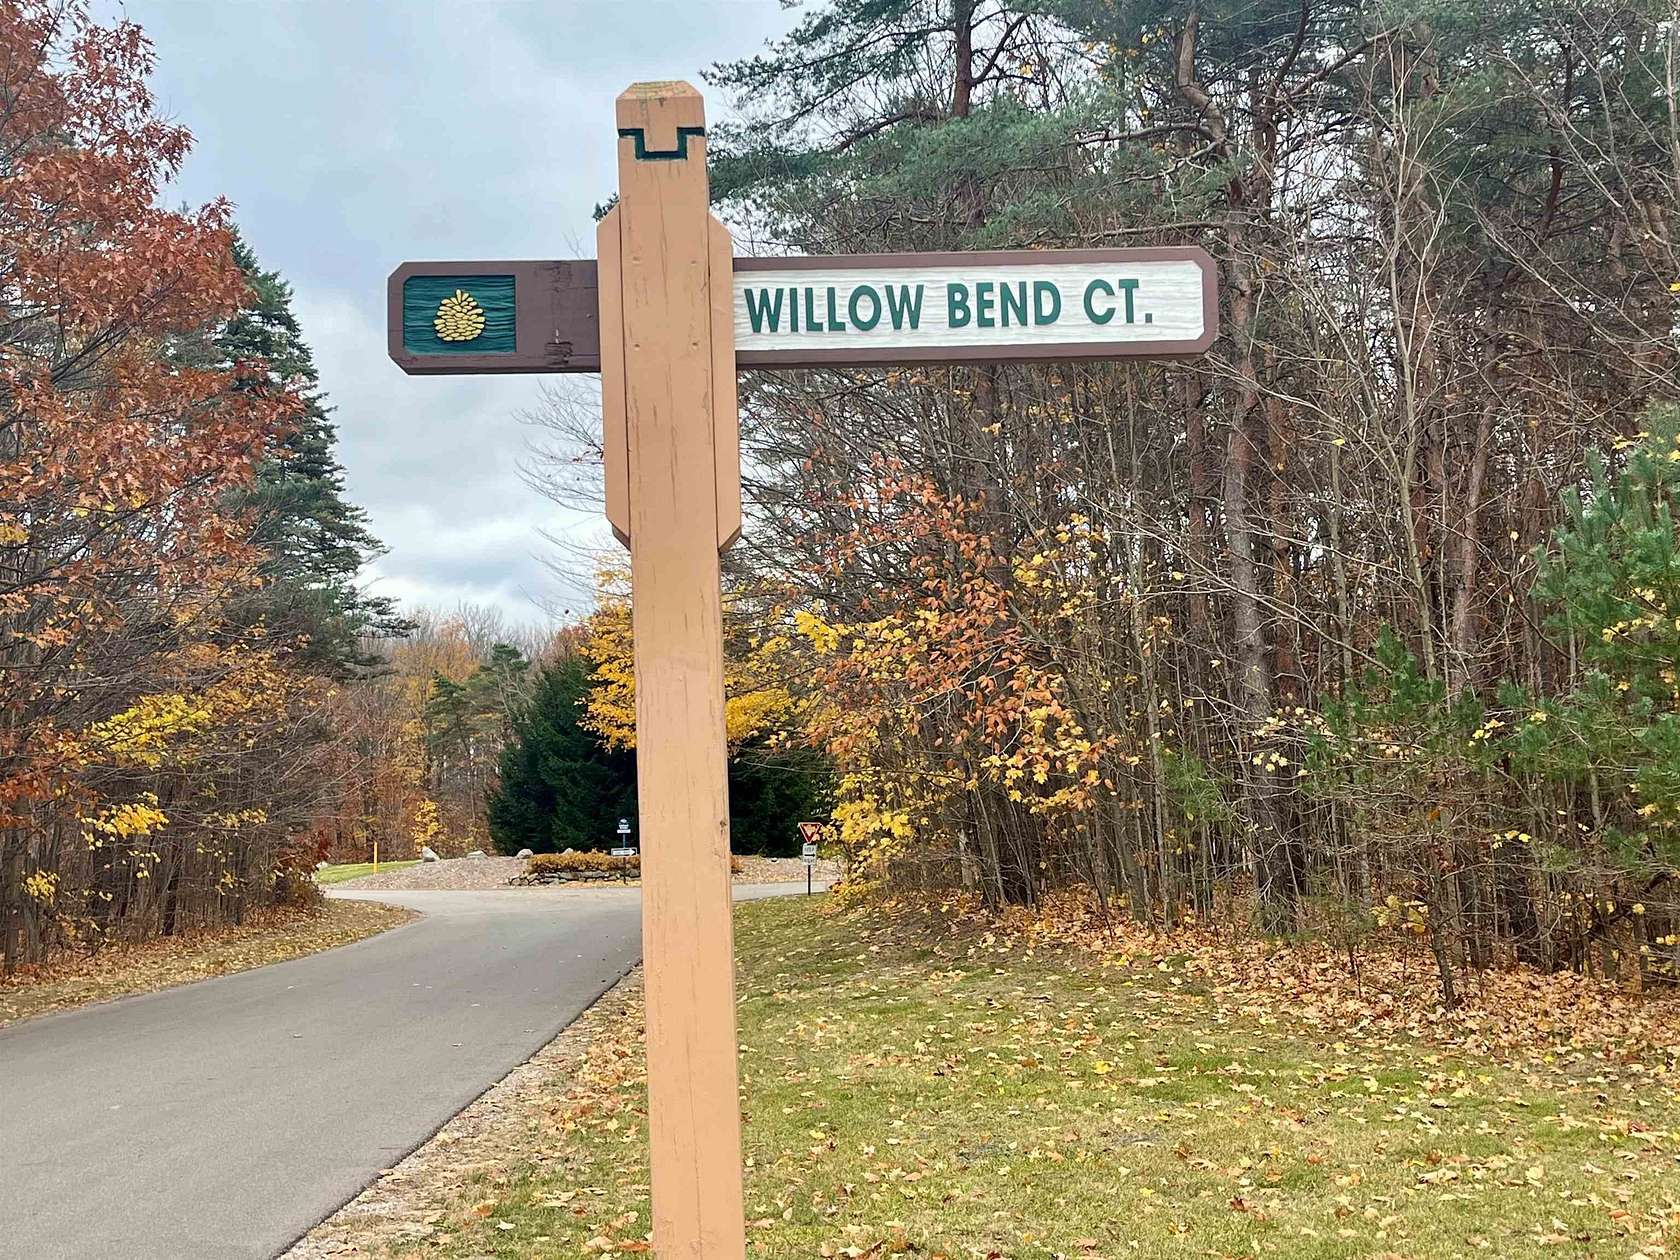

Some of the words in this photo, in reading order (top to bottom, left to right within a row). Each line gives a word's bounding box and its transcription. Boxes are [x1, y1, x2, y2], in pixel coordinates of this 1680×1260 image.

[744, 285, 924, 333] WILLOW
[947, 280, 1061, 327] BEND
[1084, 278, 1152, 325] CT.
